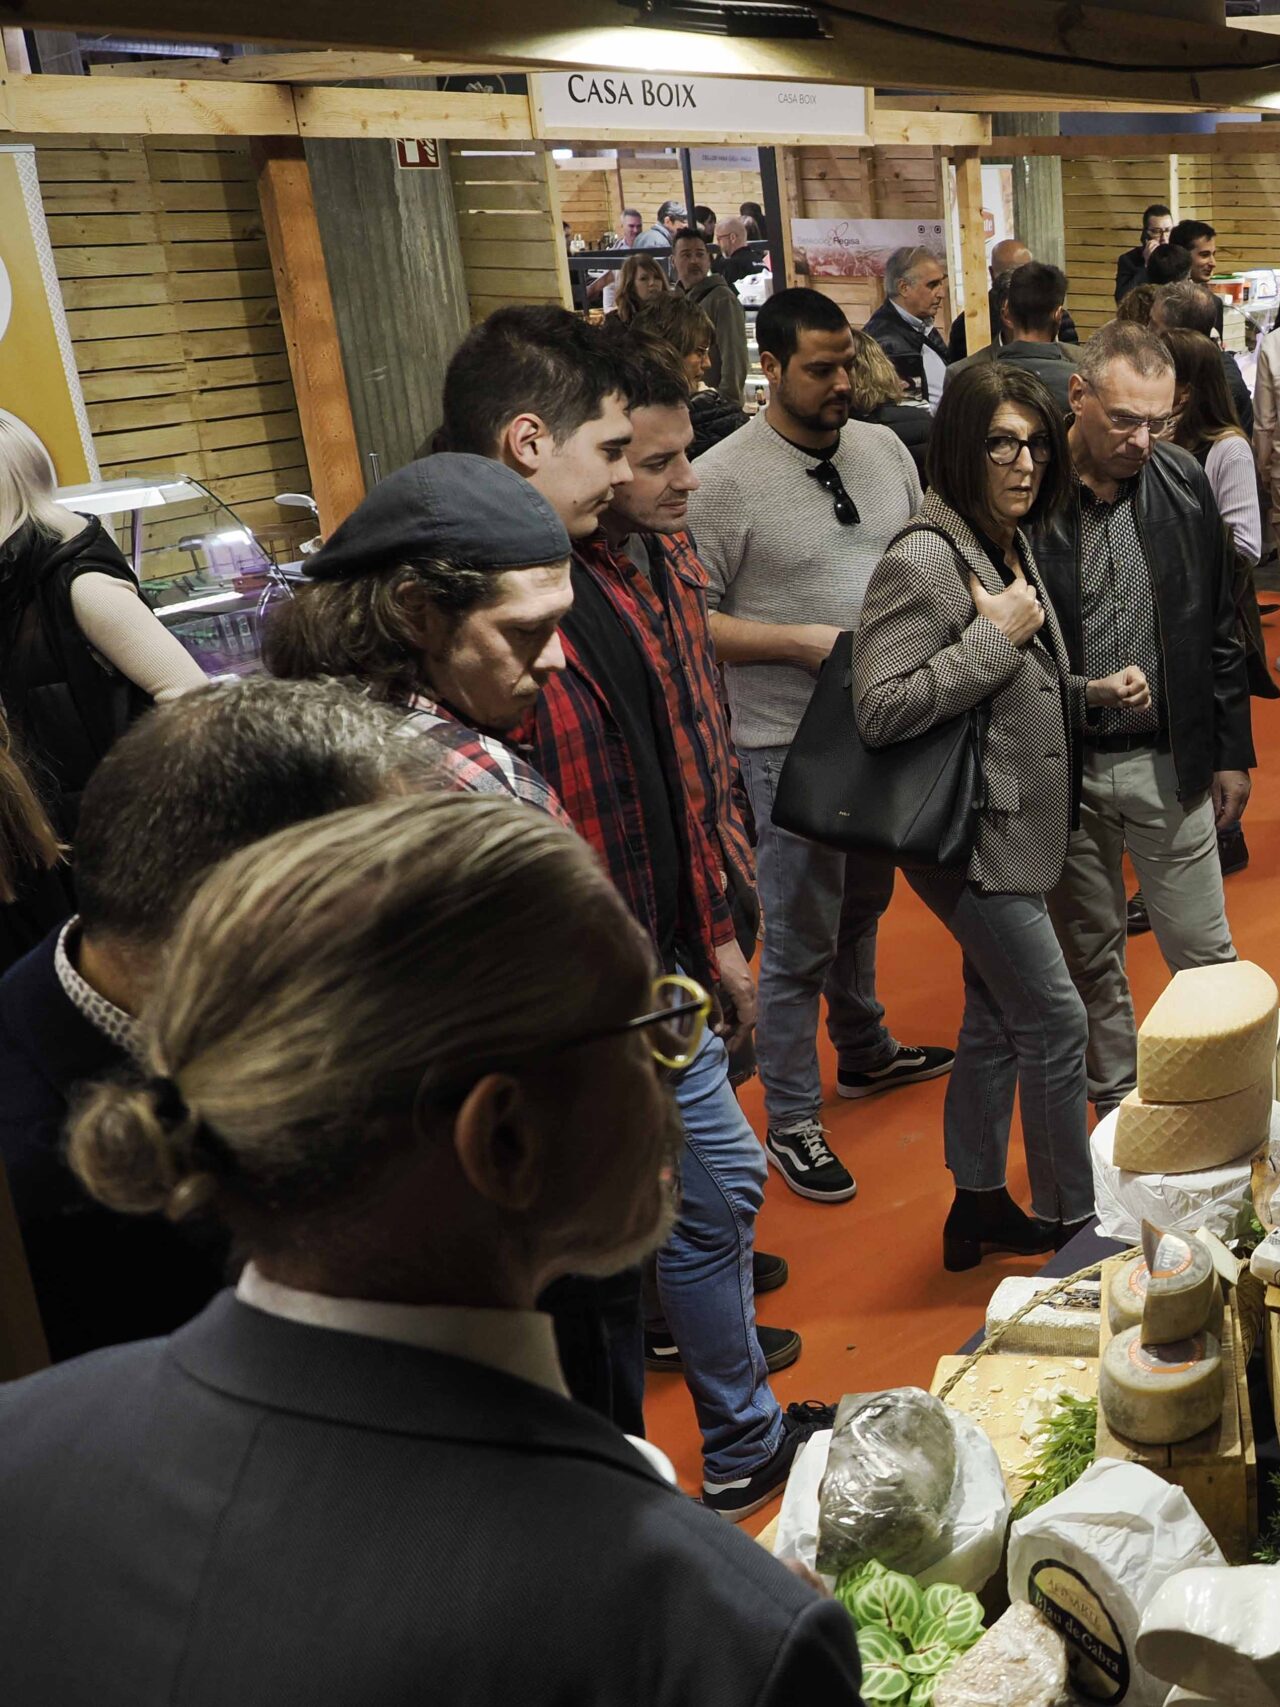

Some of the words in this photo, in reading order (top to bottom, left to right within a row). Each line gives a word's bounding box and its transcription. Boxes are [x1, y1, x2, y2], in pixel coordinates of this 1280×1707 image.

[568, 74, 634, 105] CASA
[642, 79, 697, 108] BOIX
[777, 92, 798, 105] CASA
[799, 93, 817, 105] BOIX
[1034, 1591, 1063, 1625] Blau
[1065, 1618, 1082, 1640] de
[1081, 1632, 1121, 1675] Cabra
